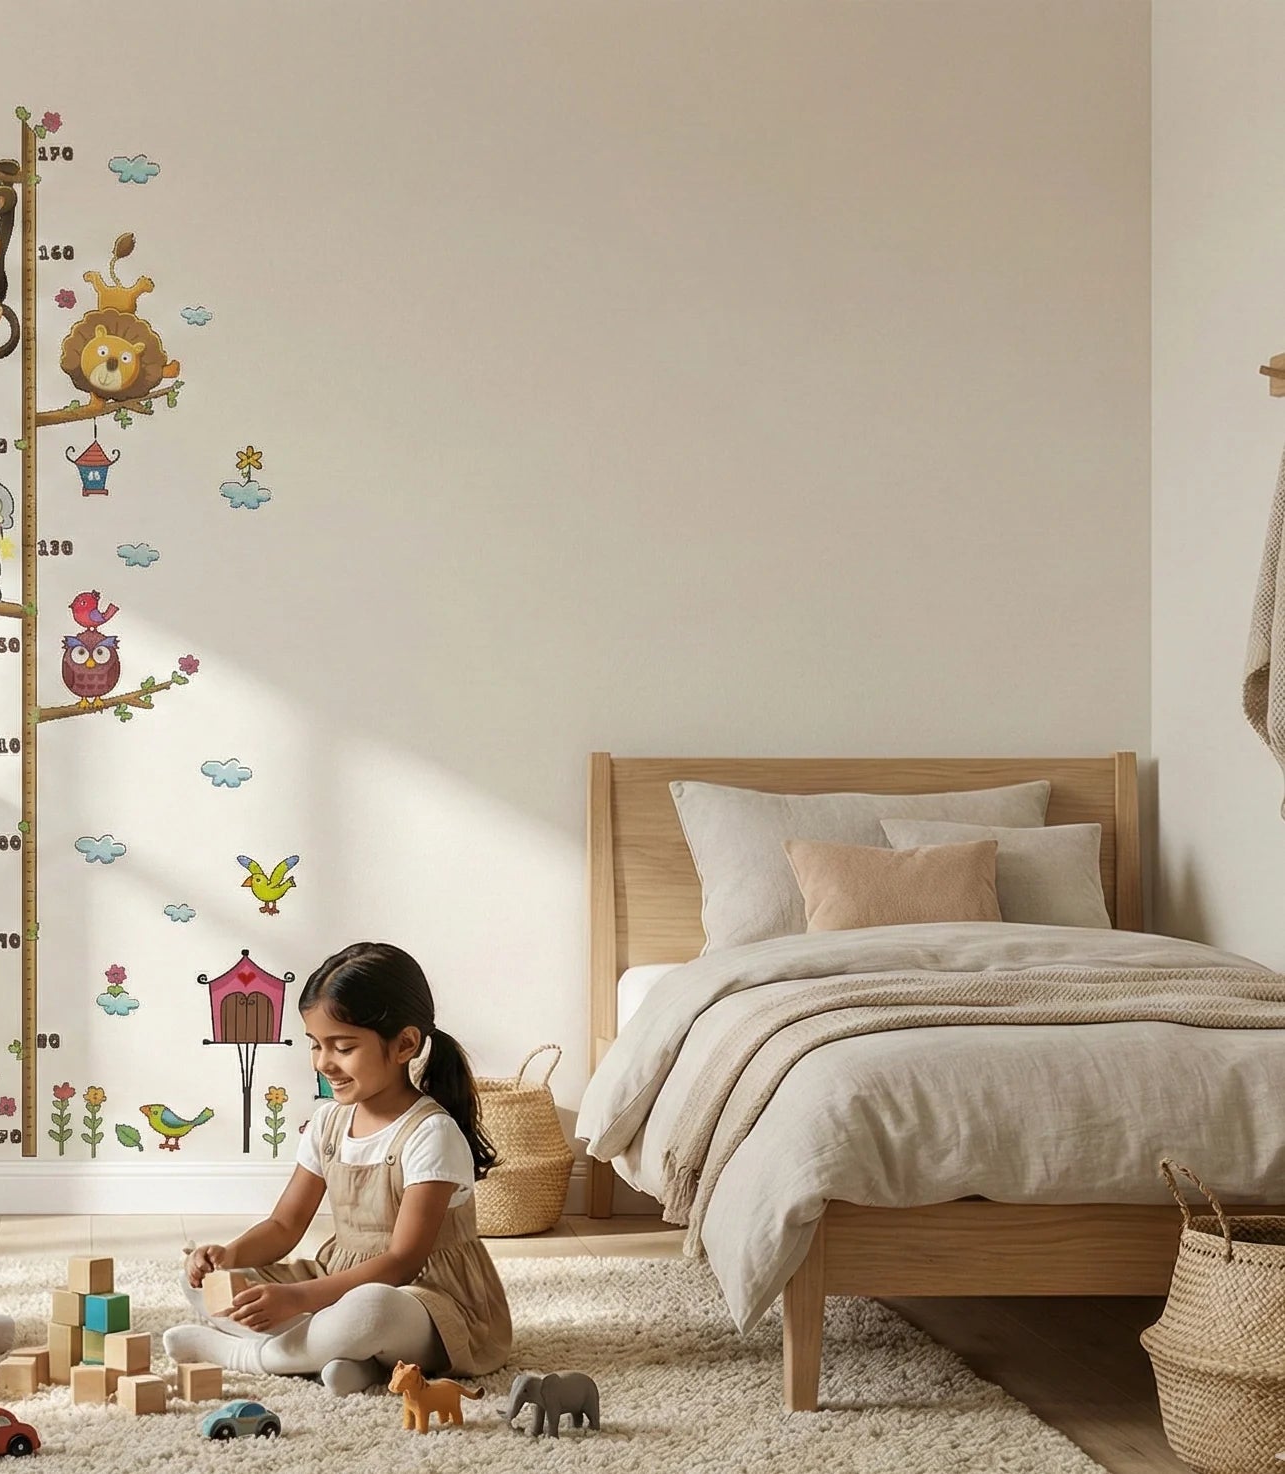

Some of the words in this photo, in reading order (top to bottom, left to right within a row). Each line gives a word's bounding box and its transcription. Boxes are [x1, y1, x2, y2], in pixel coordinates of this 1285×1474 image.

[37, 146, 74, 162] 170
[38, 245, 75, 261] 160
[37, 539, 74, 556] 130
